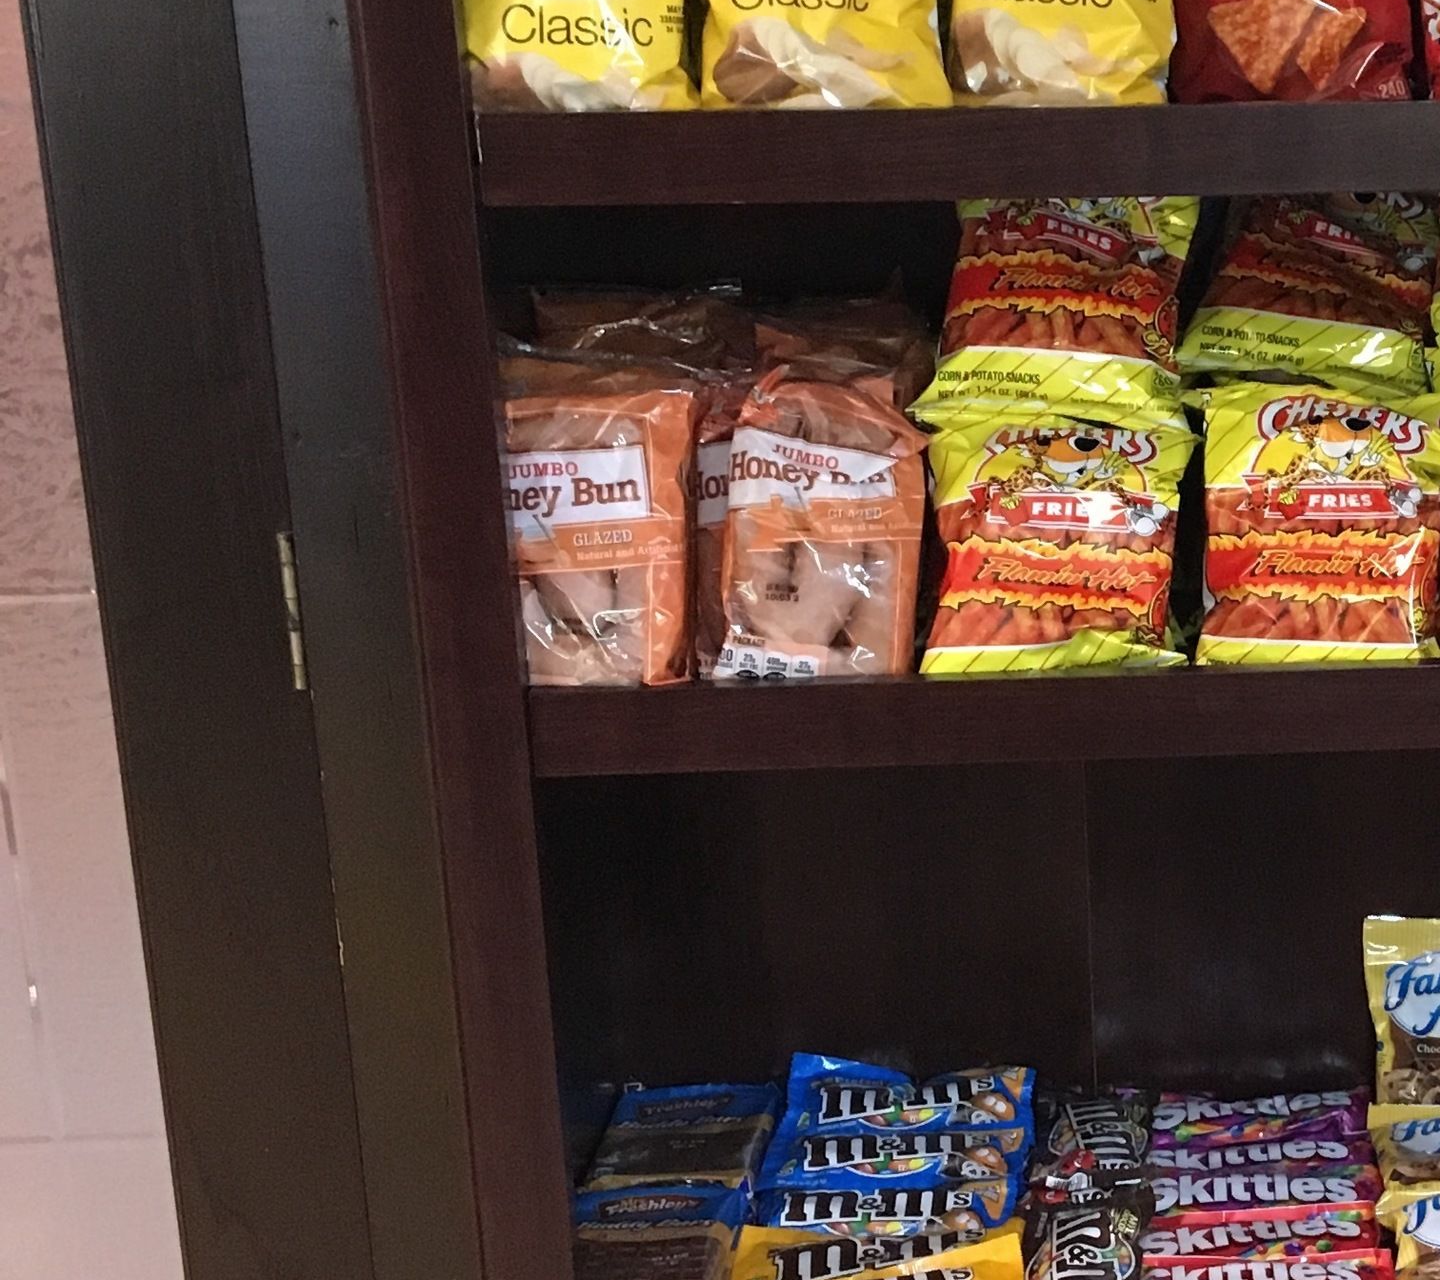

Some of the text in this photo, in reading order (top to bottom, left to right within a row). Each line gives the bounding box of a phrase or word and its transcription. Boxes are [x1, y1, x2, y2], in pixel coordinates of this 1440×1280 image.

[502, 4, 655, 47] Classic
[1047, 220, 1112, 251] FRIES
[1267, 332, 1300, 347] SNACKS
[938, 370, 1040, 384] CORN POTATO SNACKS
[508, 462, 579, 479] JUMBO
[729, 450, 821, 491] Honey
[772, 444, 840, 470] JUMBO
[508, 477, 642, 518] ney Bun
[1308, 493, 1373, 508] FRIES
[573, 529, 633, 546] GLAZED
[577, 547, 635, 561] Natural and
[1090, 564, 1157, 590] Hot
[1151, 1090, 1352, 1131] Skittles
[1147, 1141, 1349, 1171] Skittles
[1150, 1173, 1358, 1213] Skittles
[1139, 1220, 1361, 1257] Skittles
